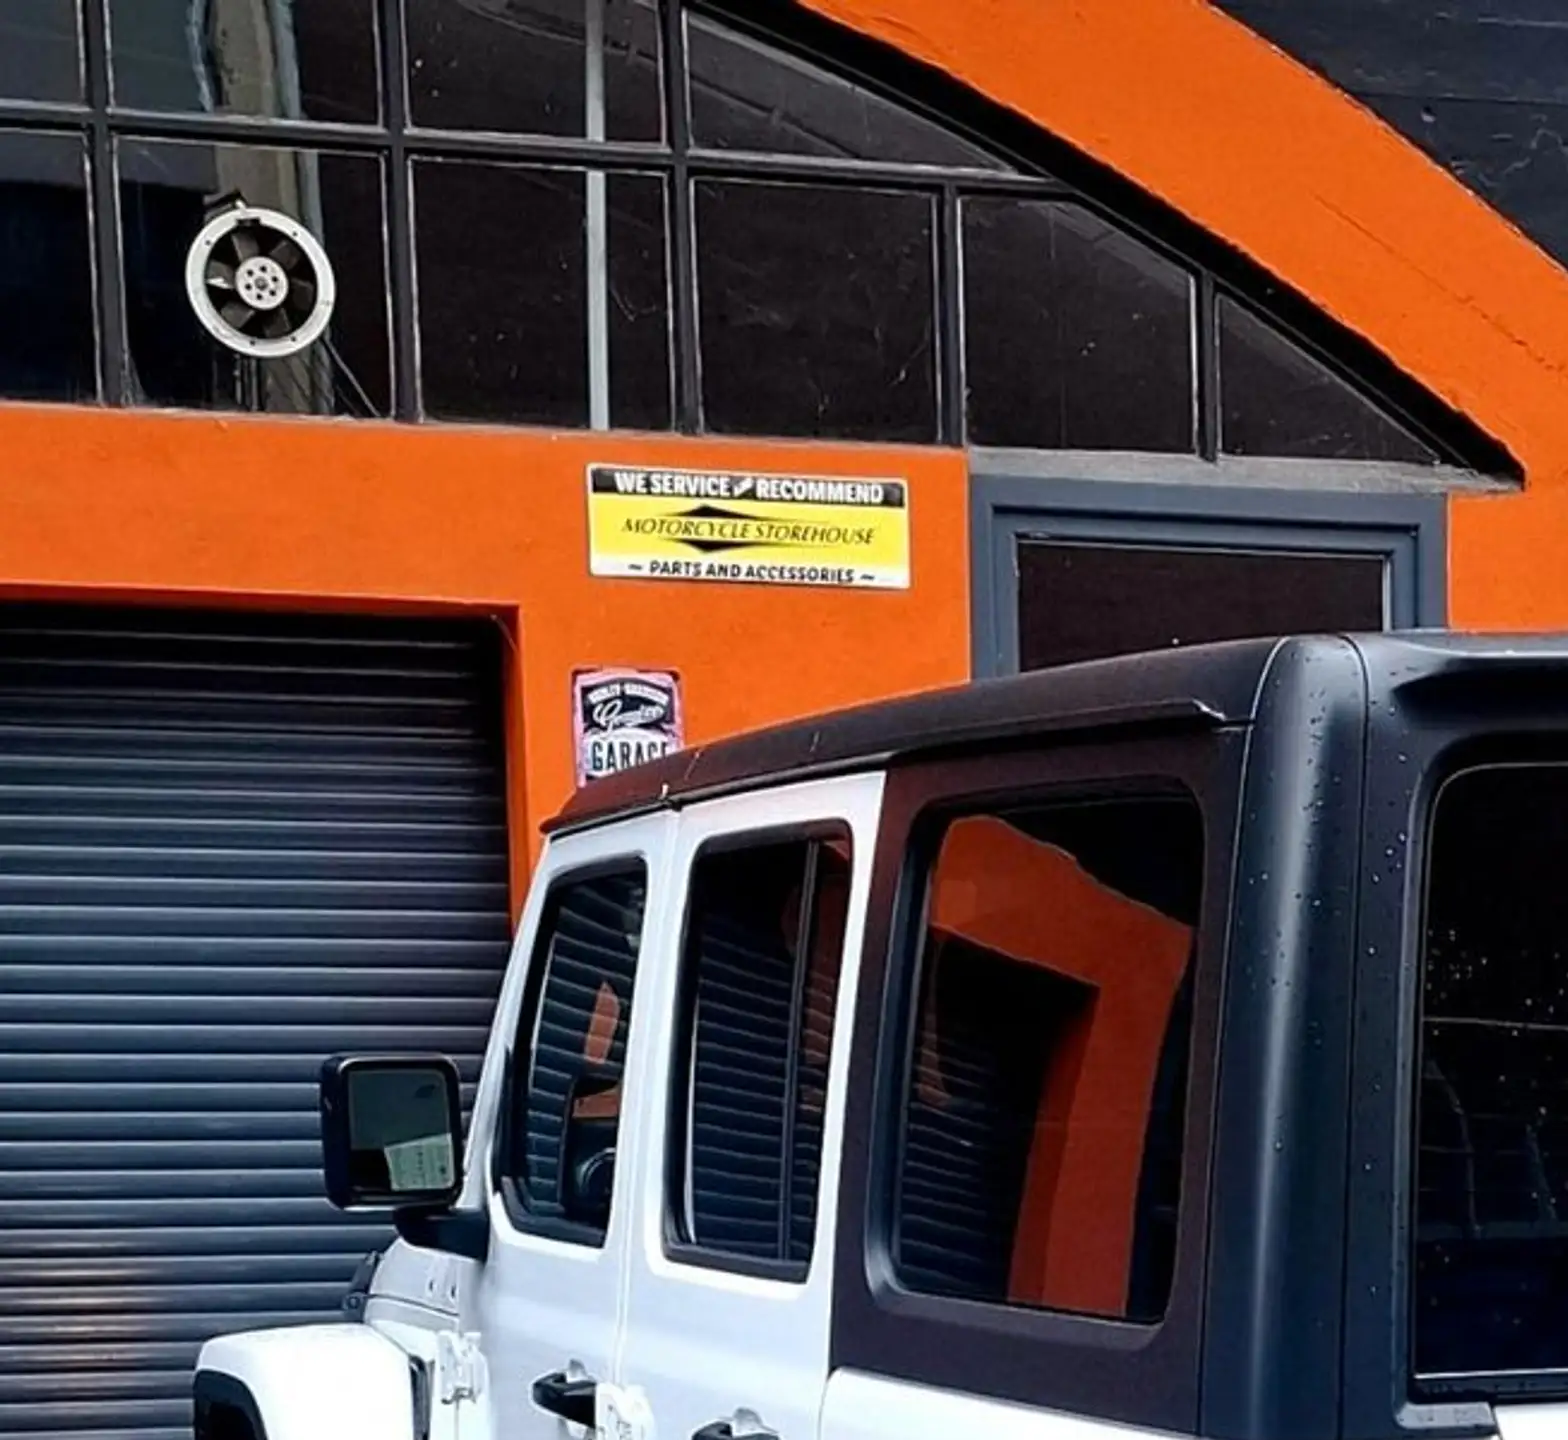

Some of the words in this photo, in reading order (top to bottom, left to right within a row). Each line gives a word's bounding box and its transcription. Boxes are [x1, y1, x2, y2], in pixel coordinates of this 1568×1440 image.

[614, 471, 648, 493] WE
[649, 472, 731, 496] SERVICE
[755, 478, 885, 504] RECOMMEND
[621, 517, 752, 539] MOTORCYCLE
[755, 523, 876, 545] STOREHOUSE
[649, 559, 702, 577] PARTS
[705, 562, 741, 578] AND
[745, 564, 855, 583] ACCESSORIES
